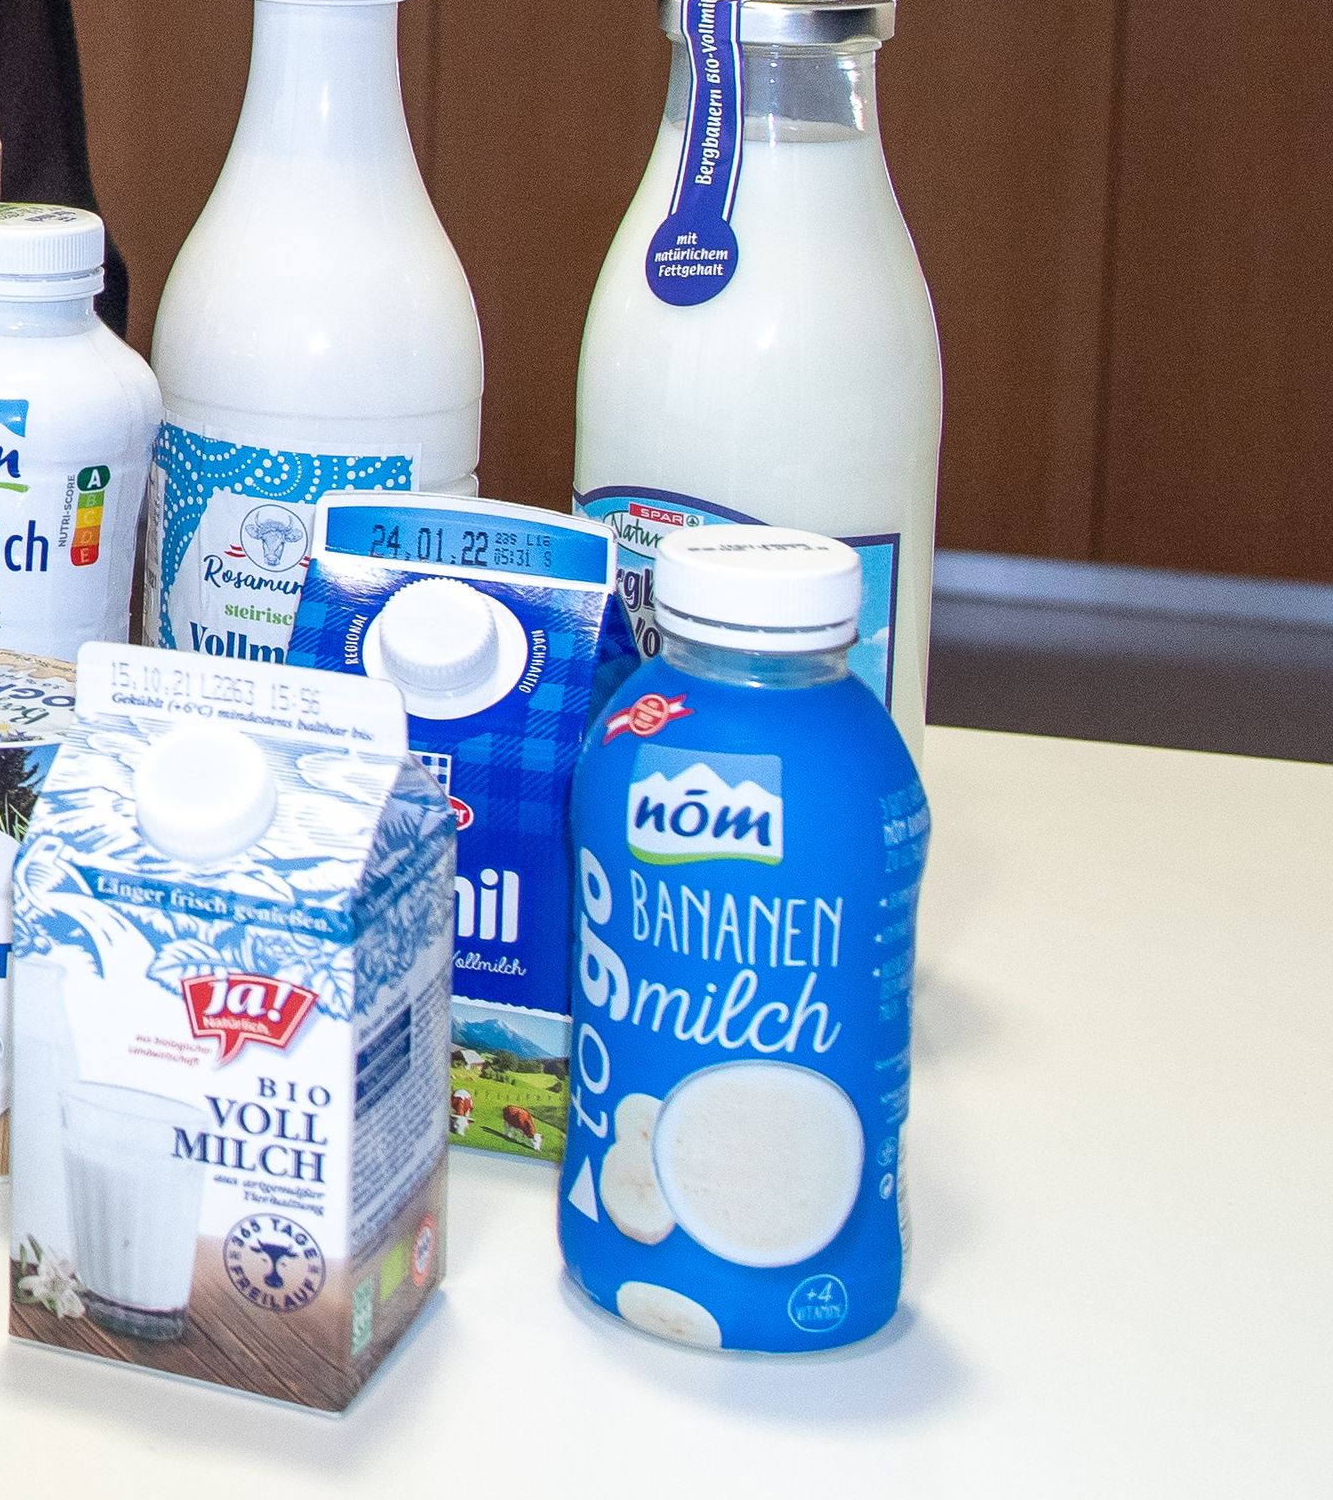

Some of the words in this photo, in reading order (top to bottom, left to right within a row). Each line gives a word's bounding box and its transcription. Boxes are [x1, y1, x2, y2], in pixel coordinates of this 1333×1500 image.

[695, 89, 723, 186] Bergbauern
[654, 248, 728, 263] natürlichem
[677, 233, 698, 245] mit
[658, 264, 724, 278] Fettgehalt
[87, 471, 103, 489] A
[59, 475, 75, 548] NUTRI-SCORE
[640, 507, 683, 524] SPAR
[369, 524, 489, 567] 24.01.22
[97, 873, 164, 906] Länger
[170, 890, 228, 914] frisch
[630, 869, 843, 968] BANANEN
[206, 965, 293, 1022] ja!
[632, 969, 842, 1053] milch
[257, 1076, 332, 1107] BIO
[204, 1094, 327, 1145] VOLL
[171, 1125, 326, 1184] MILCH
[233, 1221, 261, 1247] 365
[271, 1219, 318, 1257] TAGE
[230, 1264, 316, 1311] FREILAUF
